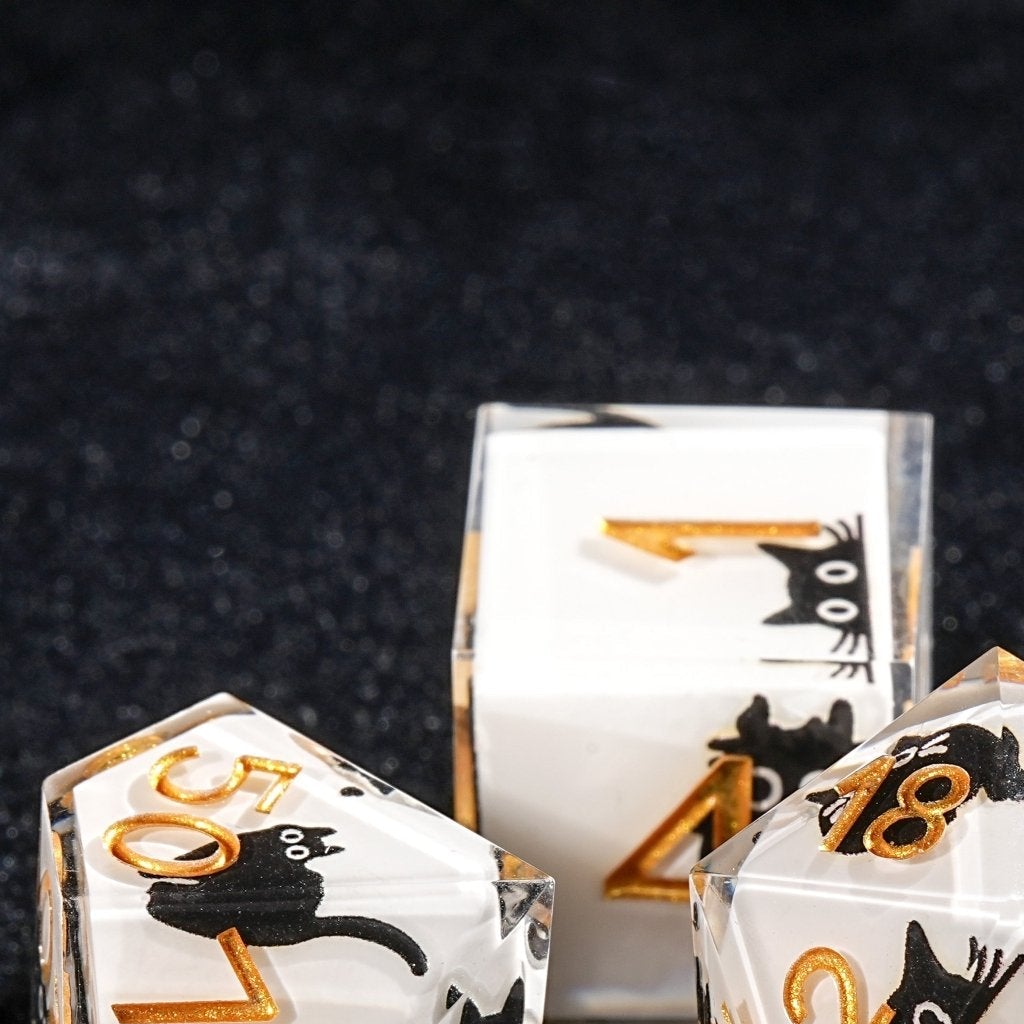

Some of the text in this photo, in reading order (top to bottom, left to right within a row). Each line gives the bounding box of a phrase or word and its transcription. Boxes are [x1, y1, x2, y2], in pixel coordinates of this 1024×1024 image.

[598, 516, 824, 564] 1
[101, 744, 303, 879] 50
[603, 754, 754, 902] 4
[820, 754, 971, 861] 18
